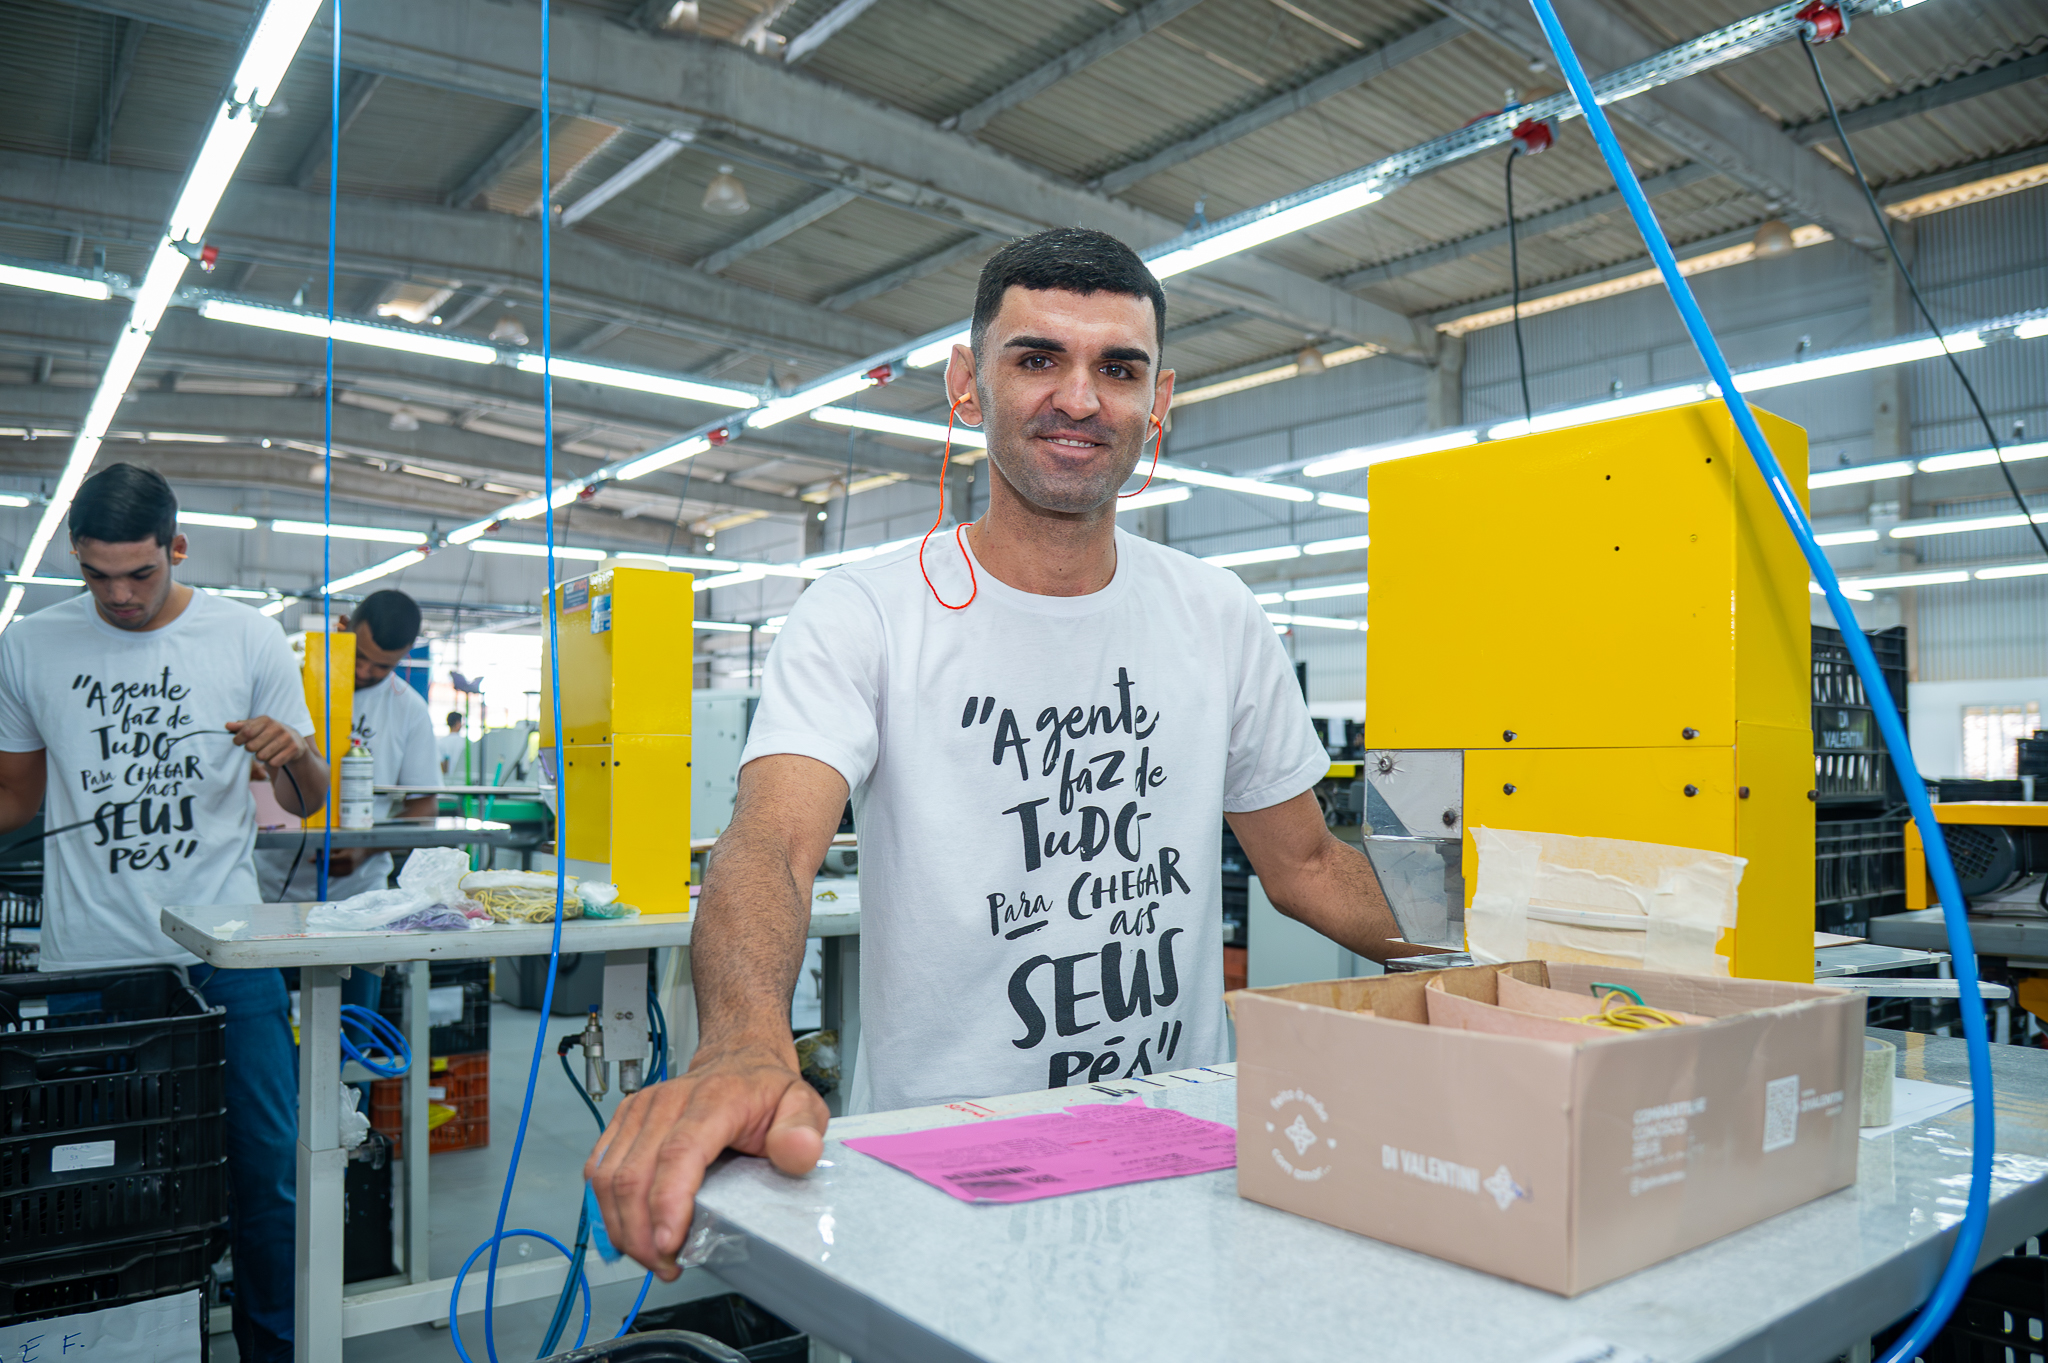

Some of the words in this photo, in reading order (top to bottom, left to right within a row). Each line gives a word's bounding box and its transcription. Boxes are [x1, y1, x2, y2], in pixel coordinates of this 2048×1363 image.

[122, 703, 161, 734] faz
[167, 705, 194, 729] de
[124, 755, 204, 786] CHEGAR
[146, 781, 183, 796] aos
[1060, 750, 1126, 815] faz
[1135, 746, 1167, 797] de
[94, 795, 197, 846] SEUS
[1067, 847, 1191, 921] CHEGAR
[1110, 901, 1160, 936] aos
[1008, 927, 1184, 1049] SEUS
[1381, 1144, 1399, 1171] DI
[1400, 1148, 1480, 1194] VALENTINI
